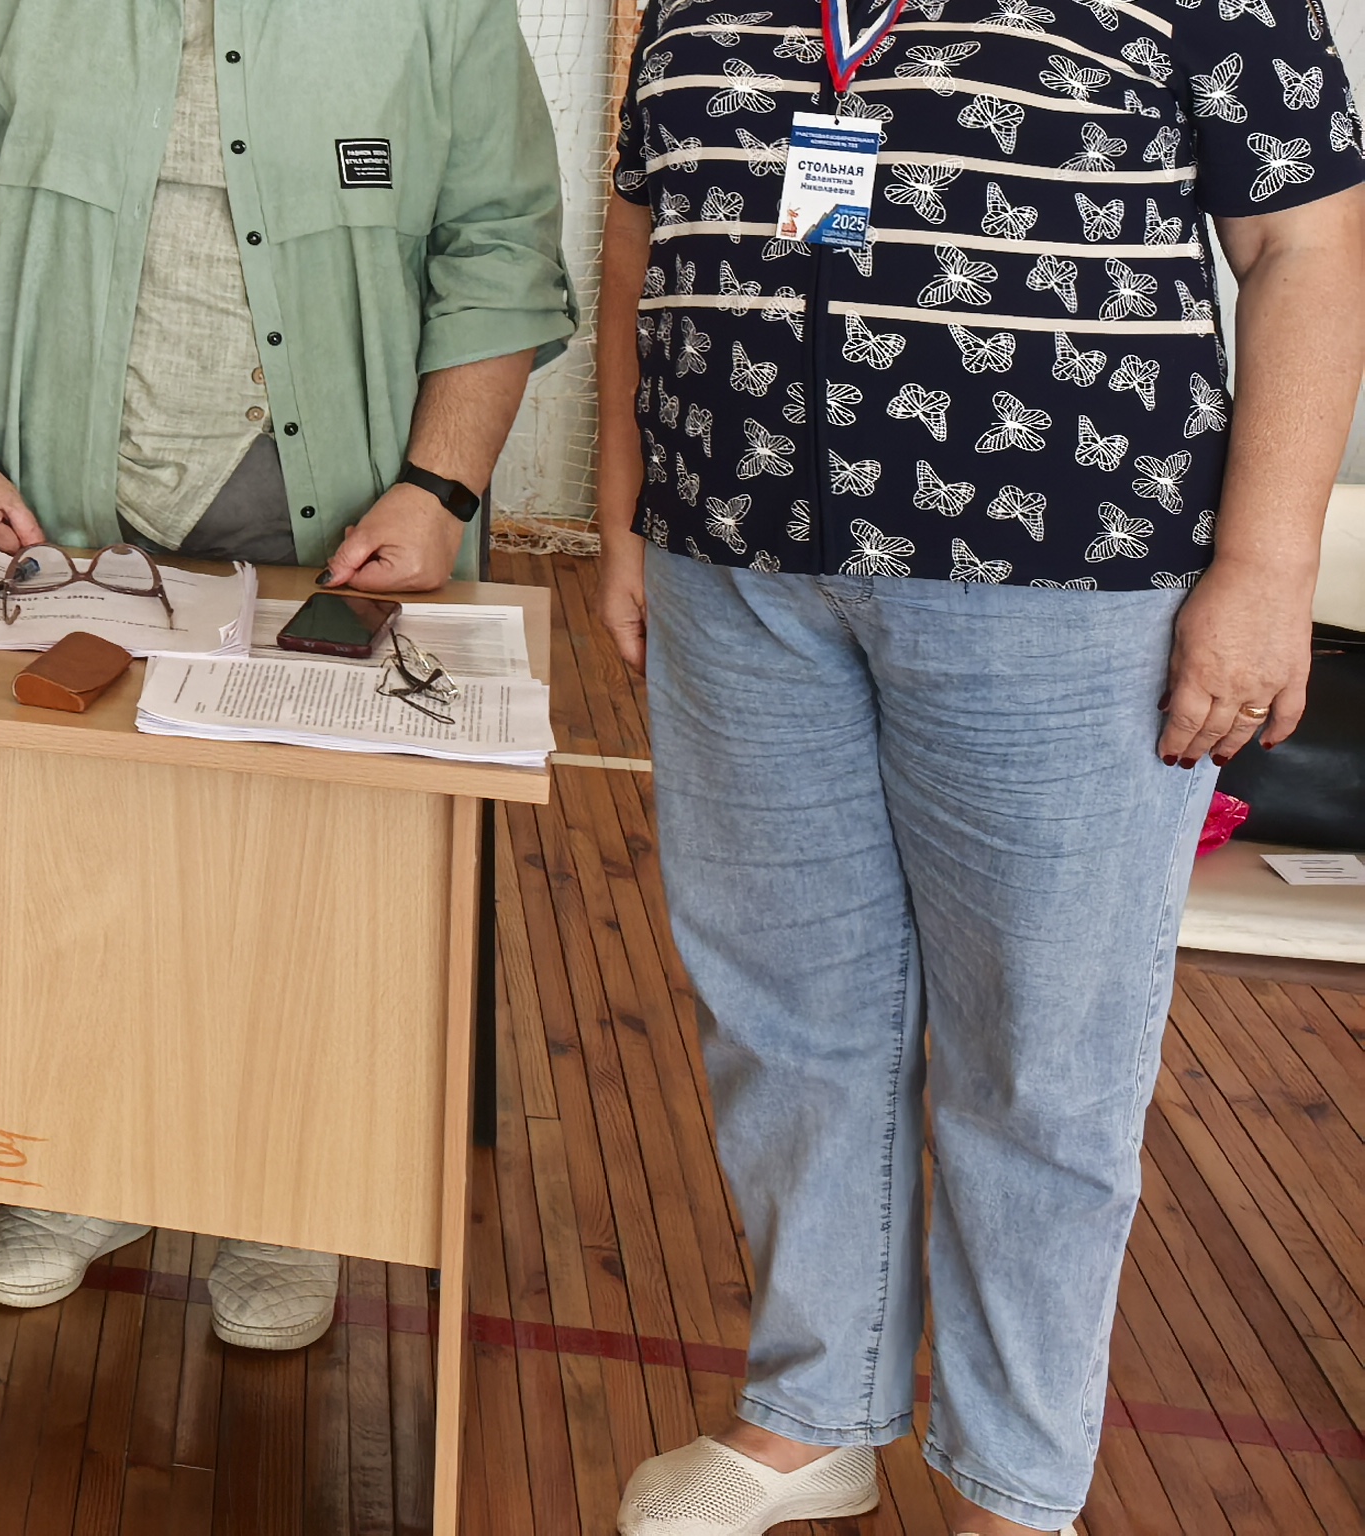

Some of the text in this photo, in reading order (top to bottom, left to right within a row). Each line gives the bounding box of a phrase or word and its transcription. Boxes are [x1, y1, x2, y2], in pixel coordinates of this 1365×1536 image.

[798, 160, 865, 177] СТОЛЬНАЯ
[805, 173, 854, 186] Валентина
[832, 213, 867, 232] 2025
